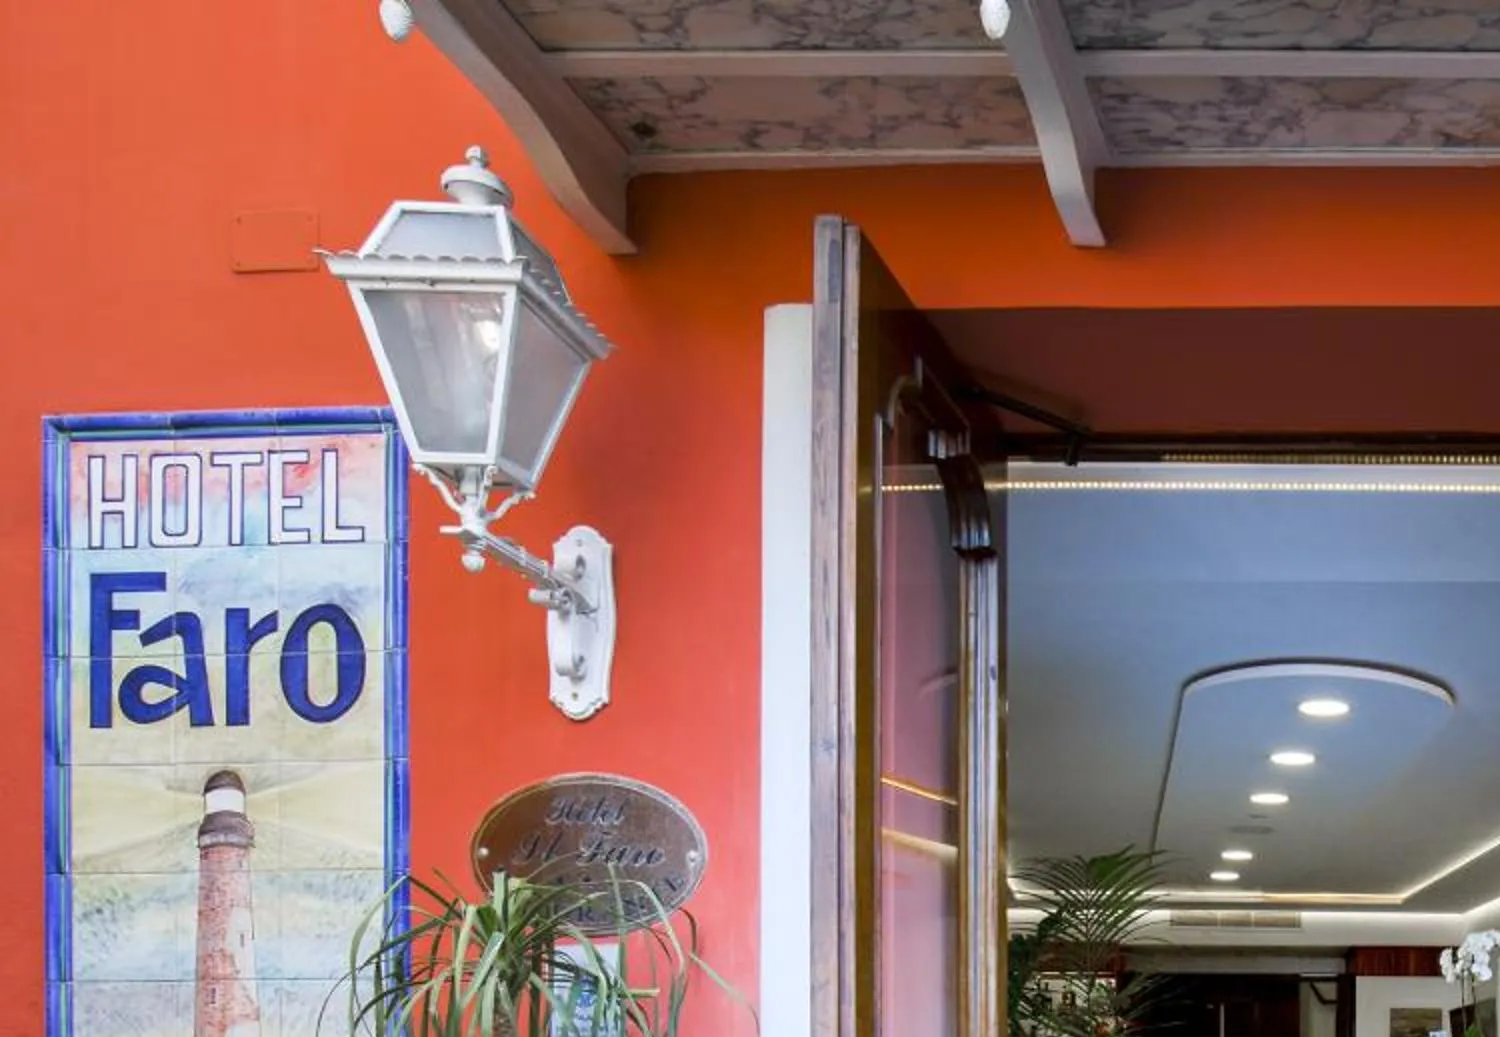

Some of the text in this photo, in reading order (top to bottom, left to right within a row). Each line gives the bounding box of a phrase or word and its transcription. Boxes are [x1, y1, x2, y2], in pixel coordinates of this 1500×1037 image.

[87, 447, 366, 550] HOTEL
[89, 570, 368, 729] Faro
[544, 796, 628, 826] Hotel
[576, 830, 667, 867] Faro
